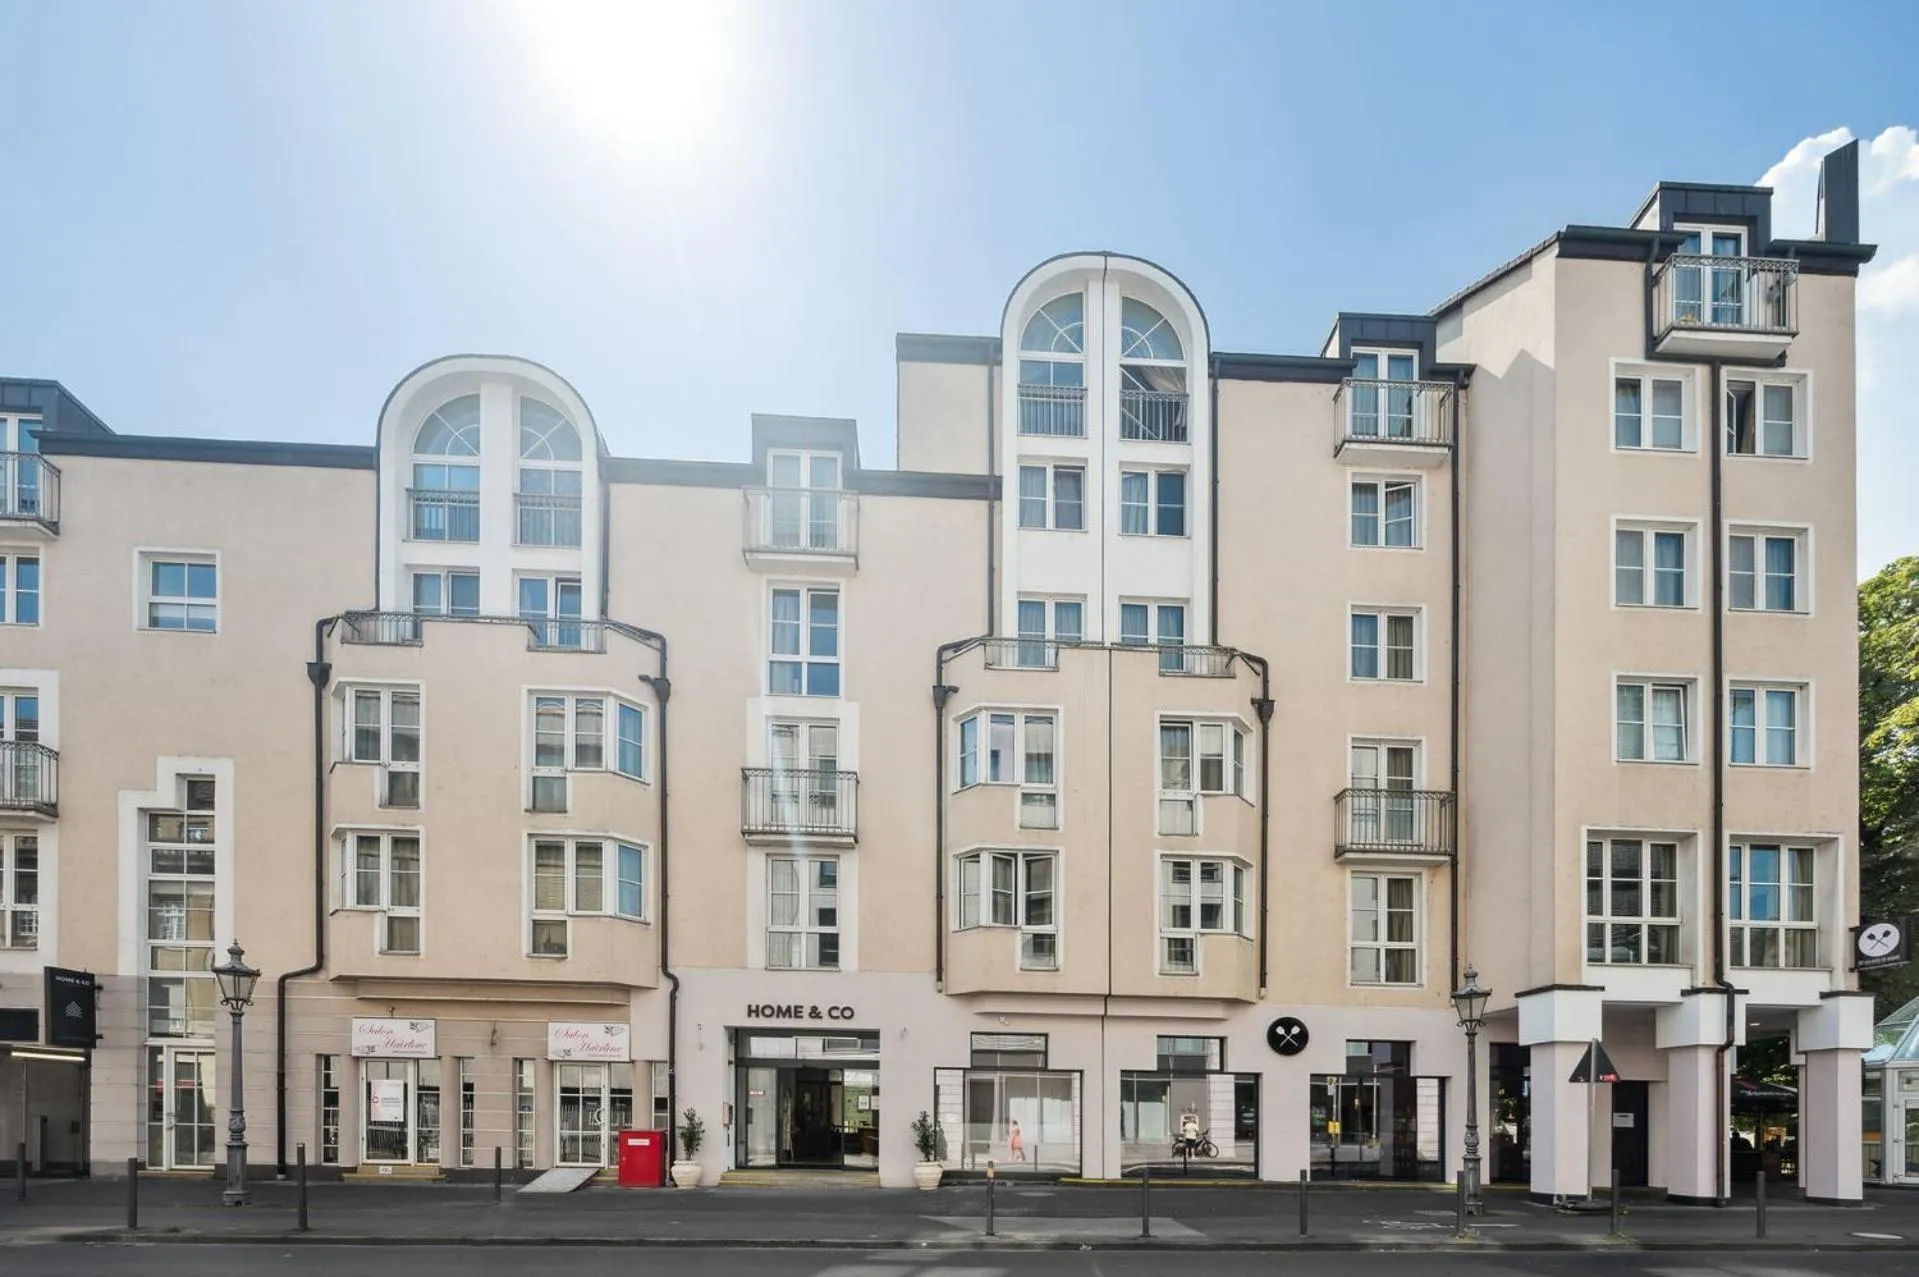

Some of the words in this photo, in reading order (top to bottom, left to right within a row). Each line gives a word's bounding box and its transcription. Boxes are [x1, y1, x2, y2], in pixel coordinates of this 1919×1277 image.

[55, 975, 75, 984] HOME
[747, 1004, 804, 1019] HOME
[808, 1005, 823, 1019] &
[828, 1006, 855, 1020] CO
[358, 1024, 394, 1036] Salon
[554, 1027, 590, 1040] Salon
